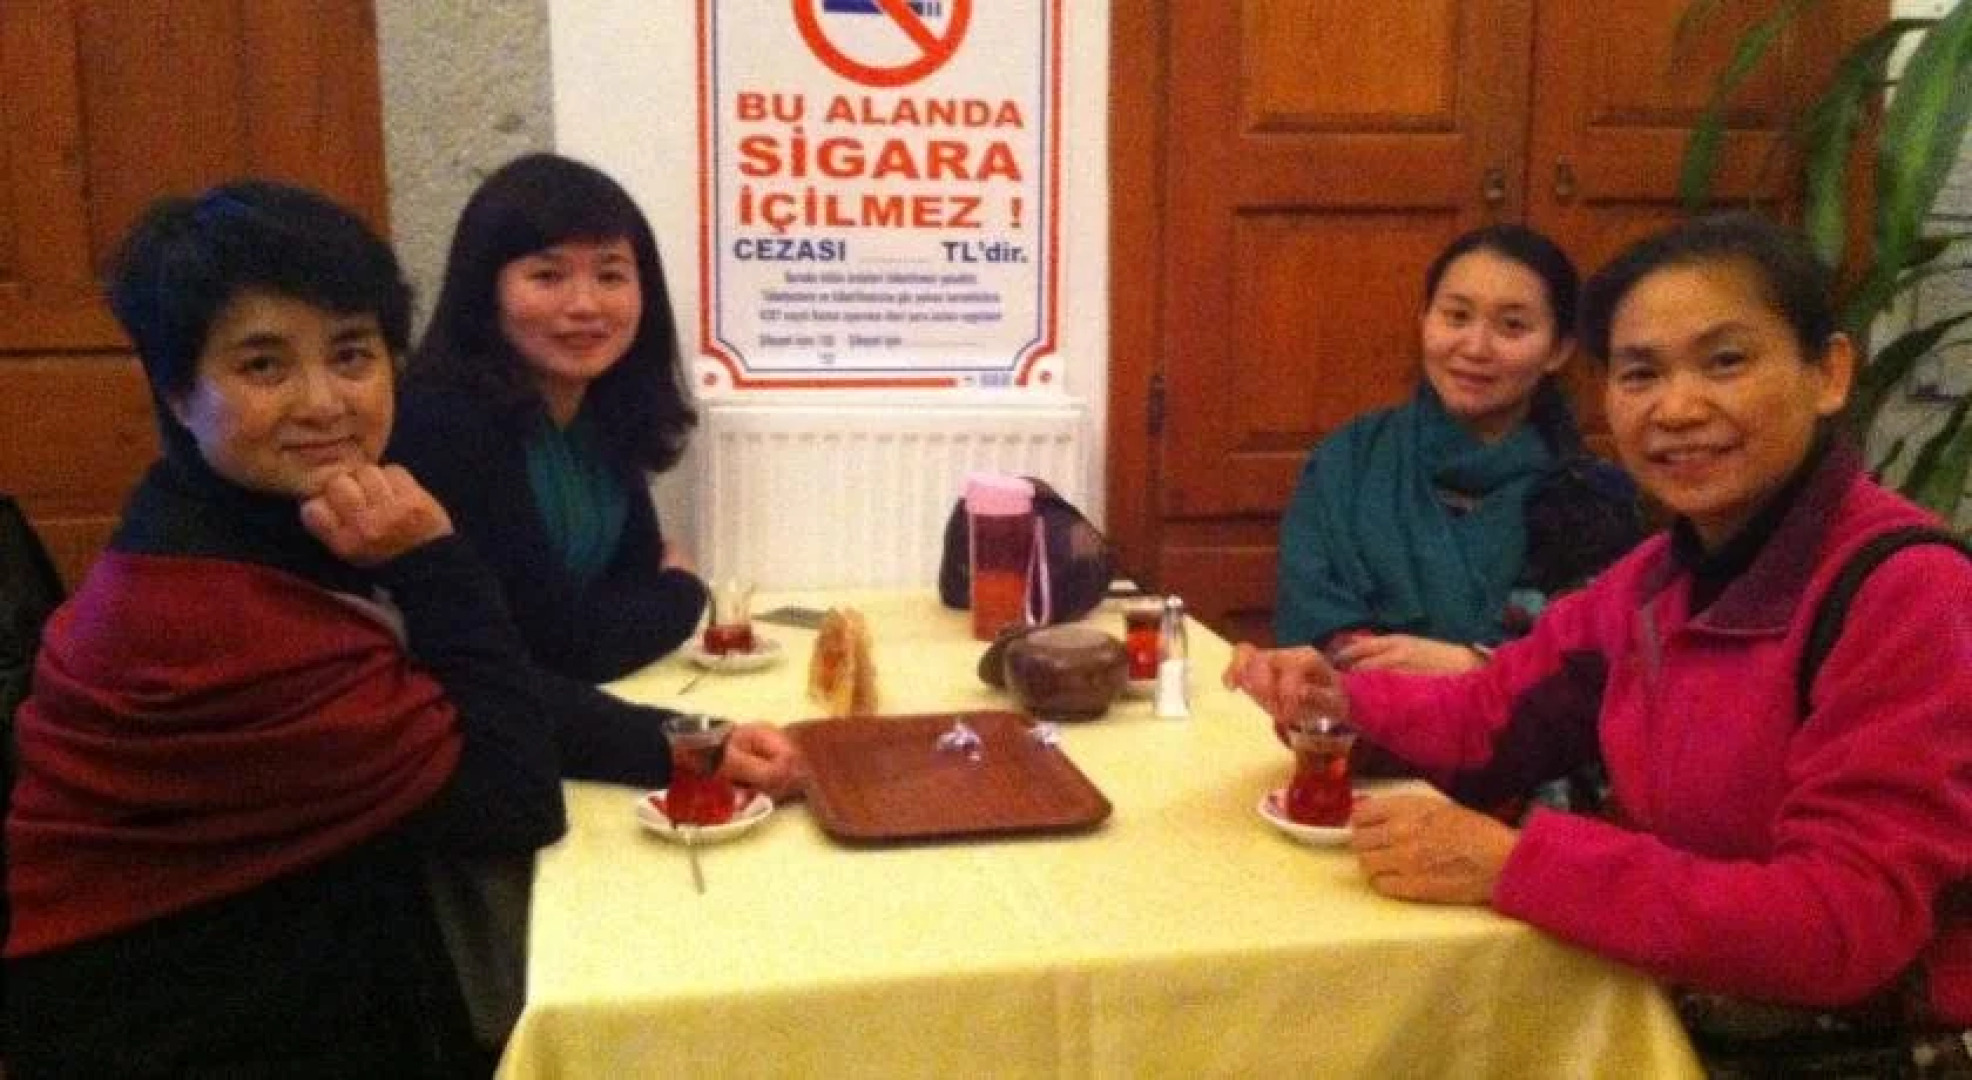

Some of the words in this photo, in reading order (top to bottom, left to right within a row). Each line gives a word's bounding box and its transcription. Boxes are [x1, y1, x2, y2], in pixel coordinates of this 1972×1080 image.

[736, 93, 804, 122] BU
[826, 95, 1024, 128] ALANDA
[738, 126, 1022, 180] SİGARA
[739, 184, 982, 233] İÇİLMEZ
[733, 239, 846, 261] CEZASI
[941, 241, 1029, 263] TL'dir.
